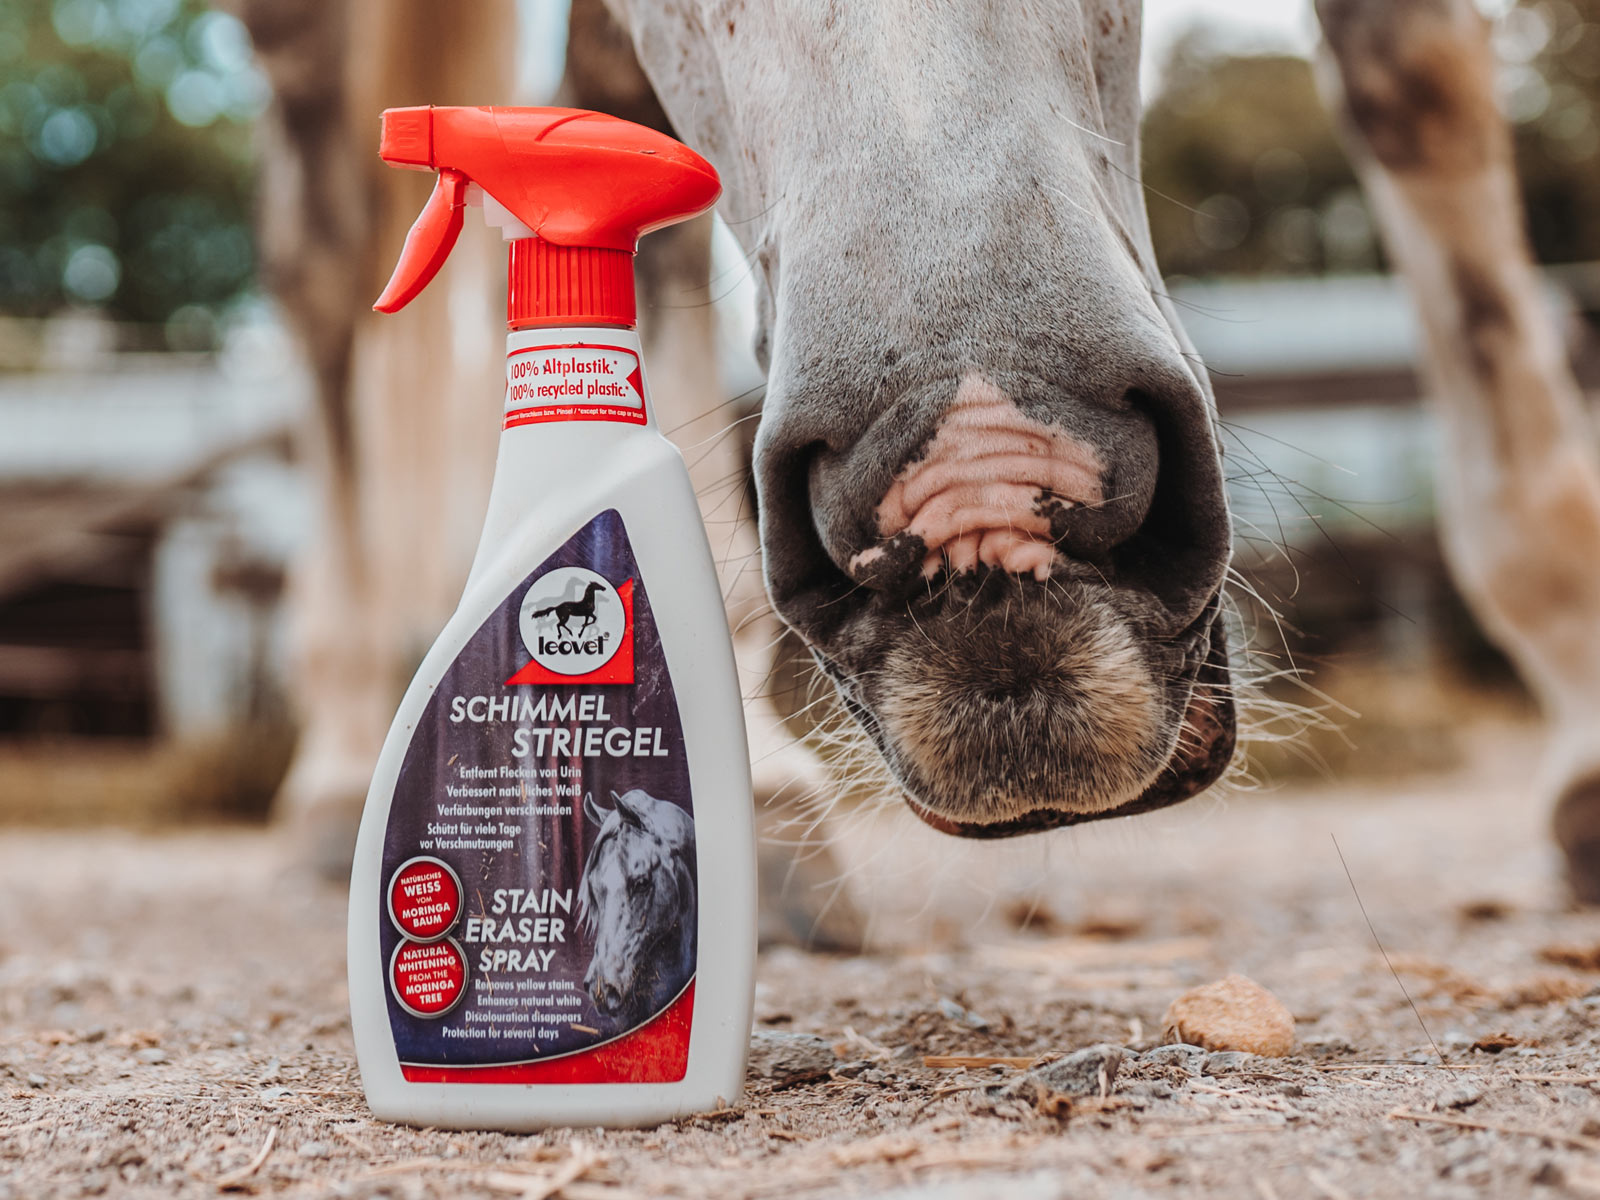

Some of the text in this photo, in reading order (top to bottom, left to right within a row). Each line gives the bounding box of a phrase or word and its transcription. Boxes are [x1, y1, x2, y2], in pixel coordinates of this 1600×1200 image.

[510, 360, 539, 380] 100%
[510, 383, 534, 402] 100%
[537, 379, 583, 399] recycled
[449, 693, 611, 722] SCHIMMEL
[511, 727, 669, 758] STRIEGEL
[460, 766, 582, 779] Entfernt Flecken von Urin
[446, 784, 581, 797] Verbessert natüliches Weiß
[437, 803, 572, 819] Verfärbungen verschwinden
[427, 822, 521, 837] Schützt für viele Tage
[419, 837, 514, 852] vor Verschmutzungen
[400, 872, 442, 885] NATÜRLICHES
[404, 881, 441, 897] WEISS
[416, 896, 432, 904] VOM
[491, 888, 573, 914] STAIN
[402, 903, 451, 919] MORINGA
[413, 914, 442, 928] BAUM
[465, 917, 566, 943] ERASER
[403, 946, 448, 961] NATURAL
[478, 949, 556, 972] SPRAY
[398, 956, 456, 973] WHITENING
[409, 970, 448, 983] FROM THE
[405, 980, 455, 995] MORINGA
[475, 978, 575, 993] Removes yellow stains
[420, 992, 442, 1005] TREE
[477, 994, 582, 1007] Enhances natural white
[465, 1010, 582, 1025] Discolouration disappears
[442, 1026, 559, 1040] Protection for several days
